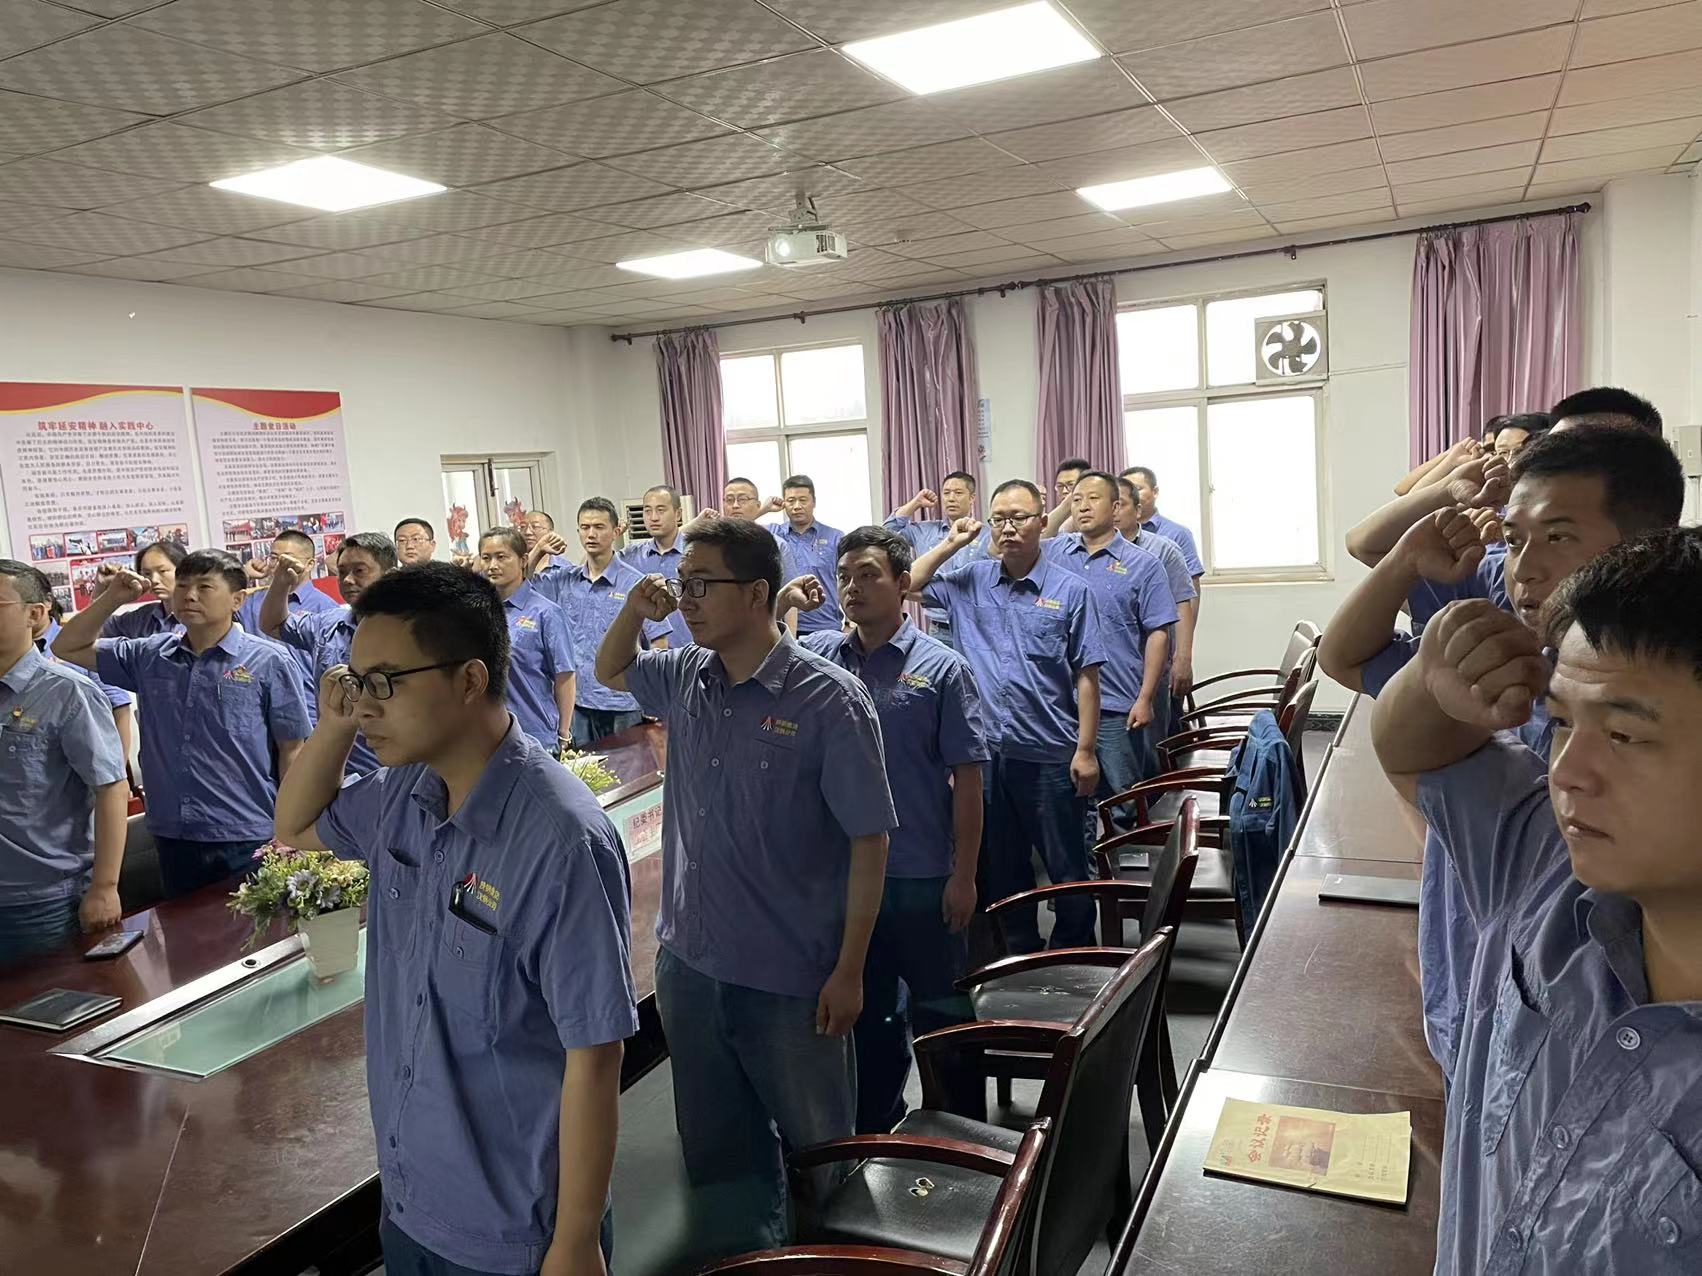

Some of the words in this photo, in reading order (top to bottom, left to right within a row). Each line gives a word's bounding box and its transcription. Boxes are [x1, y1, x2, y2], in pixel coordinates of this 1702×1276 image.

[253, 422, 297, 431] 主题党日活动
[1248, 1113, 1272, 1163] 会议记录
